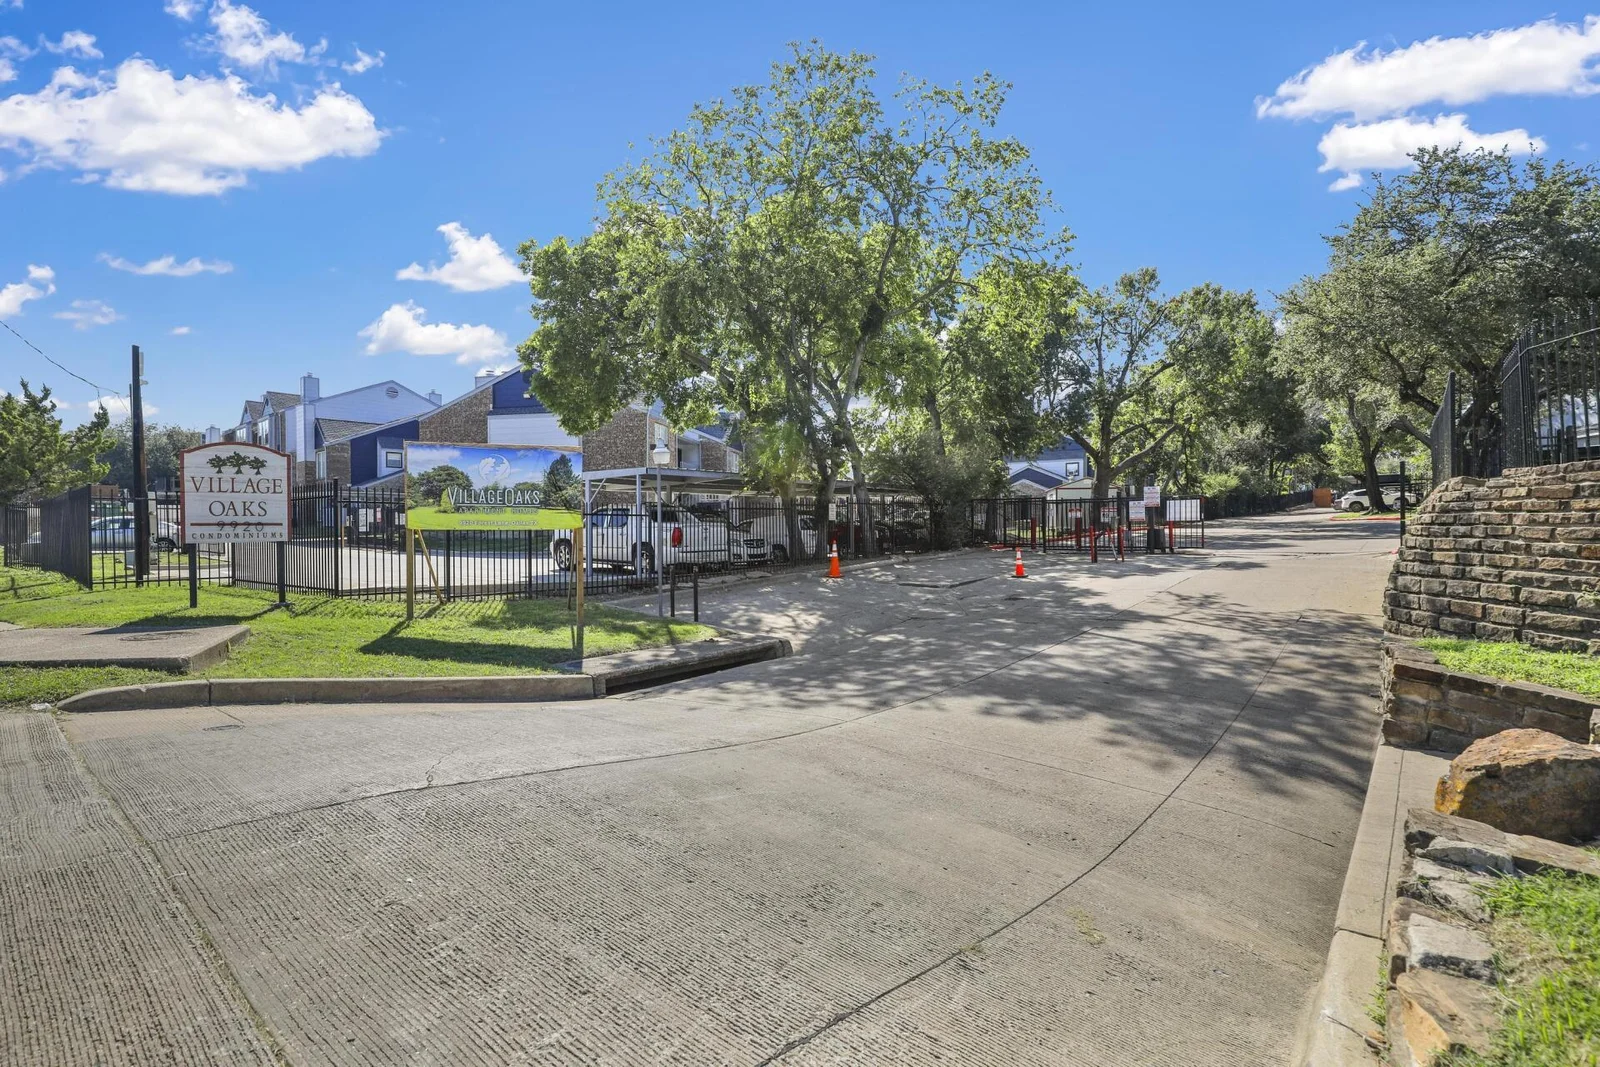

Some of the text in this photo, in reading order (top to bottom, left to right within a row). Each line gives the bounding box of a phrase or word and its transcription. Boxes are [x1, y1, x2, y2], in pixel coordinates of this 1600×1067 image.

[190, 476, 283, 494] VILLAGE
[208, 500, 267, 517] OAKS
[217, 520, 264, 532] 9920
[191, 532, 283, 540] CONDOMINIUMS
